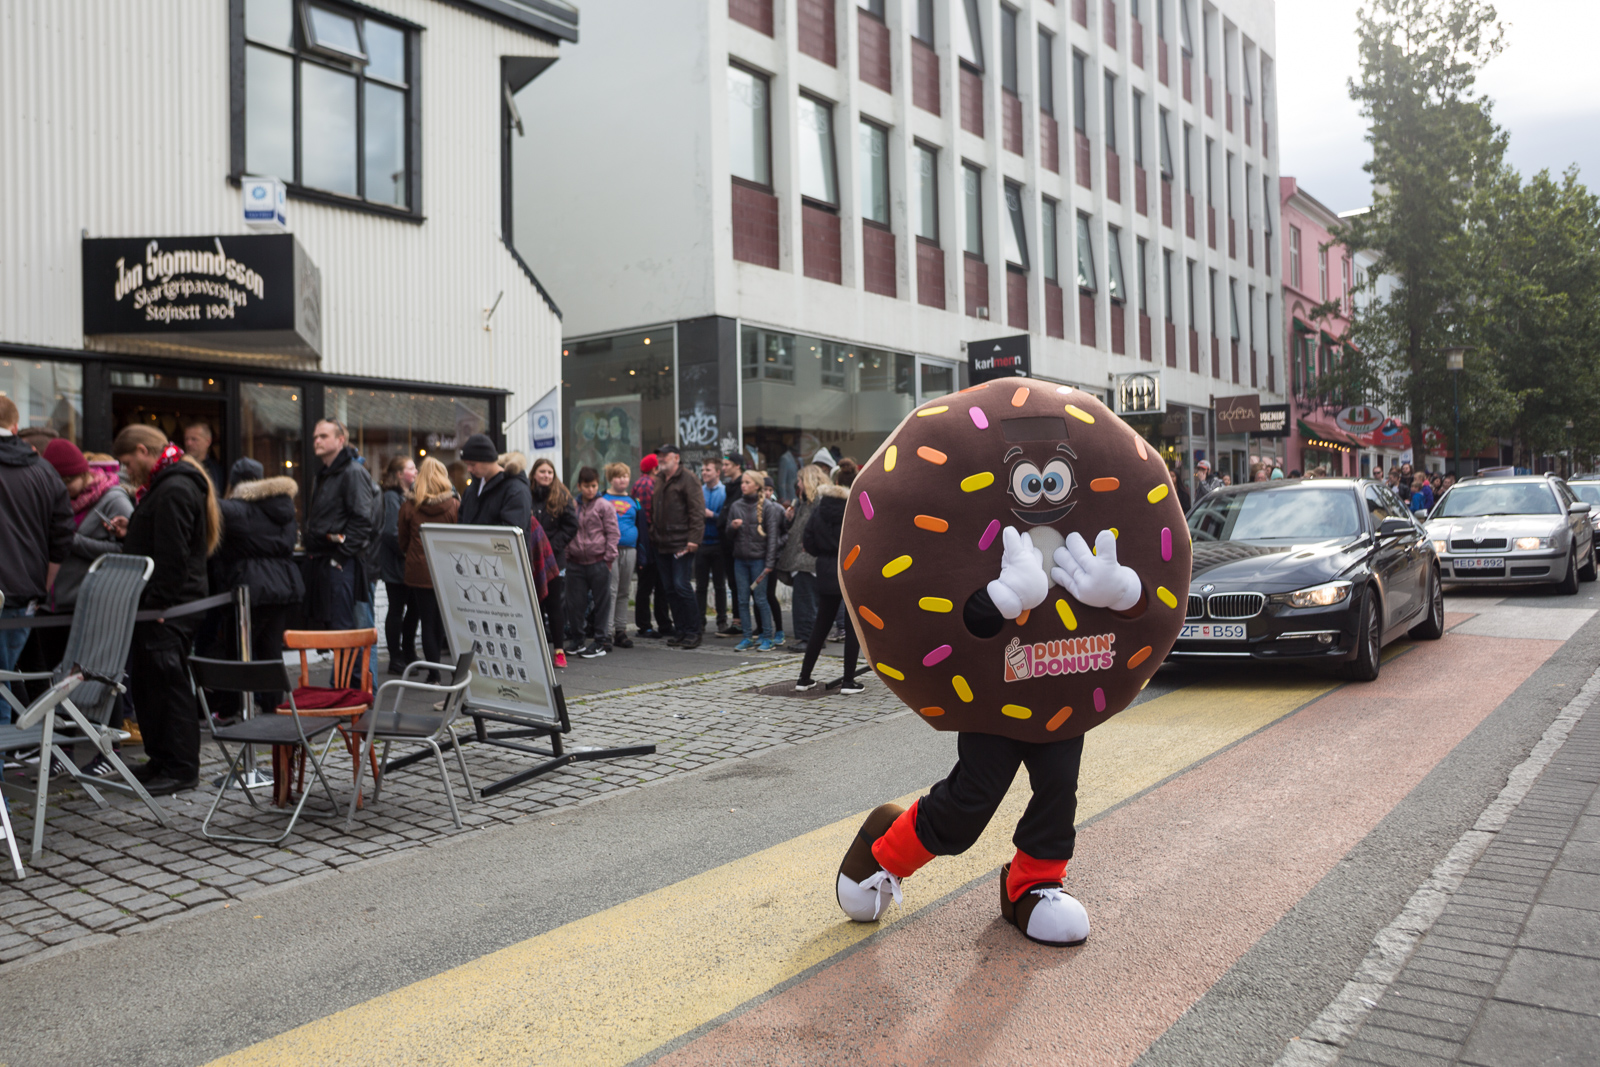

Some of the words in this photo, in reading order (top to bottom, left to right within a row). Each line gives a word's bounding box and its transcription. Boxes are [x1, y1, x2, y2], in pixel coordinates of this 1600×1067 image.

[146, 236, 264, 300] Sigmundsson
[145, 303, 201, 324] Stofnsett
[206, 303, 235, 319] 1904
[975, 355, 1021, 370] karlmenn
[1483, 560, 1503, 568] 892
[1180, 625, 1200, 638] ZF
[1213, 625, 1244, 638] B59
[1034, 633, 1116, 661] DUNKIN'
[1034, 652, 1113, 677] DONUTS
